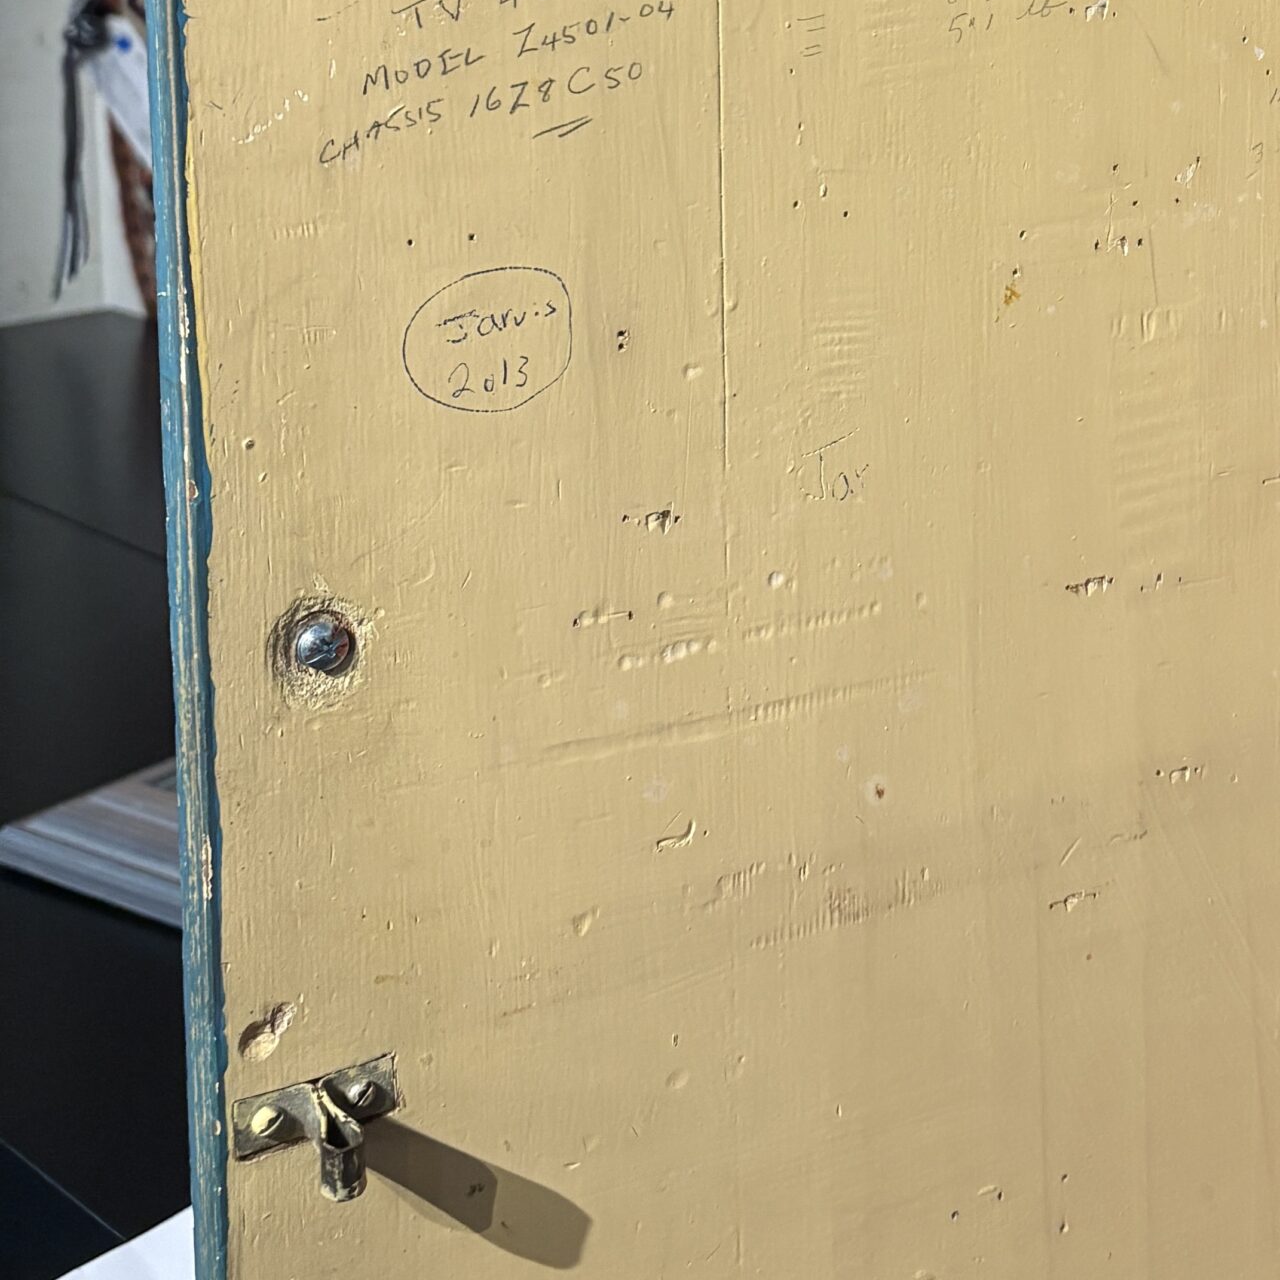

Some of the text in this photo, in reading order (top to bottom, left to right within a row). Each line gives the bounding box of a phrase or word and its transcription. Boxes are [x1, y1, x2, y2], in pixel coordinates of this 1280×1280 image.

[362, 48, 485, 96] MODEL
[318, 98, 446, 165] CHASSIS
[437, 301, 557, 344] Jarvis
[449, 355, 530, 398] 2013
